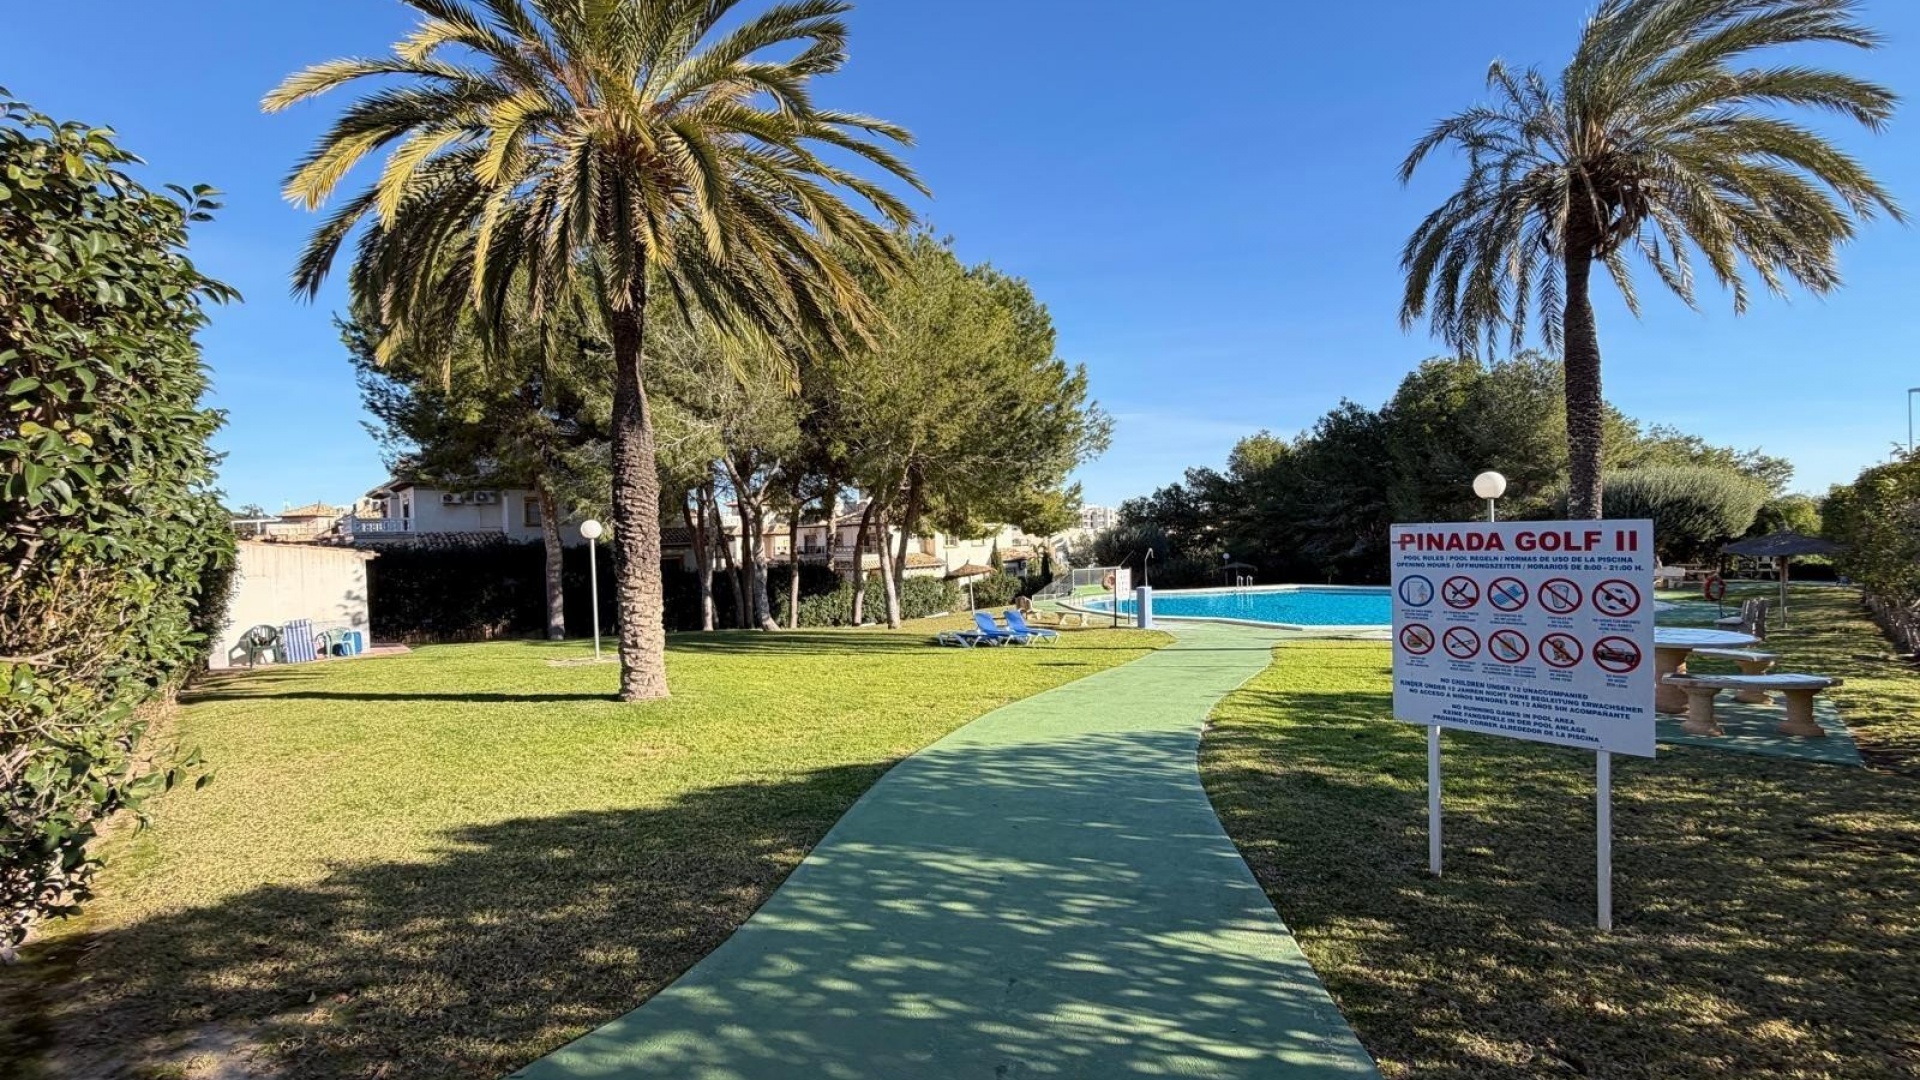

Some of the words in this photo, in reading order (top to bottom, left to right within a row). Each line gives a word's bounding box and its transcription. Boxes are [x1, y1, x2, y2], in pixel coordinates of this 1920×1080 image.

[1400, 532, 1505, 551] PINADA
[1515, 531, 1602, 552] GOLF
[1616, 530, 1638, 551] II
[1452, 679, 1485, 688] CHILDREN
[1523, 688, 1588, 700] UNACCOMPANIED
[1457, 687, 1484, 695] JAHREN
[1531, 695, 1579, 706] BEGLEITUNG
[1581, 701, 1644, 713] ERWACHSENER
[1463, 705, 1494, 714] RUNNING
[1496, 709, 1521, 718] GAMES
[1475, 696, 1508, 705] MENORES
[1570, 707, 1630, 720] ACOMPAÑANTE
[1433, 714, 1468, 724] PROHIBIDO
[1470, 719, 1498, 728] CORRER
[1499, 723, 1542, 735] ALREDEDOR
[1567, 733, 1599, 742] PISCINA
[1464, 712, 1506, 722] FANGSPIELE
[1555, 724, 1587, 733] ANLAGE
